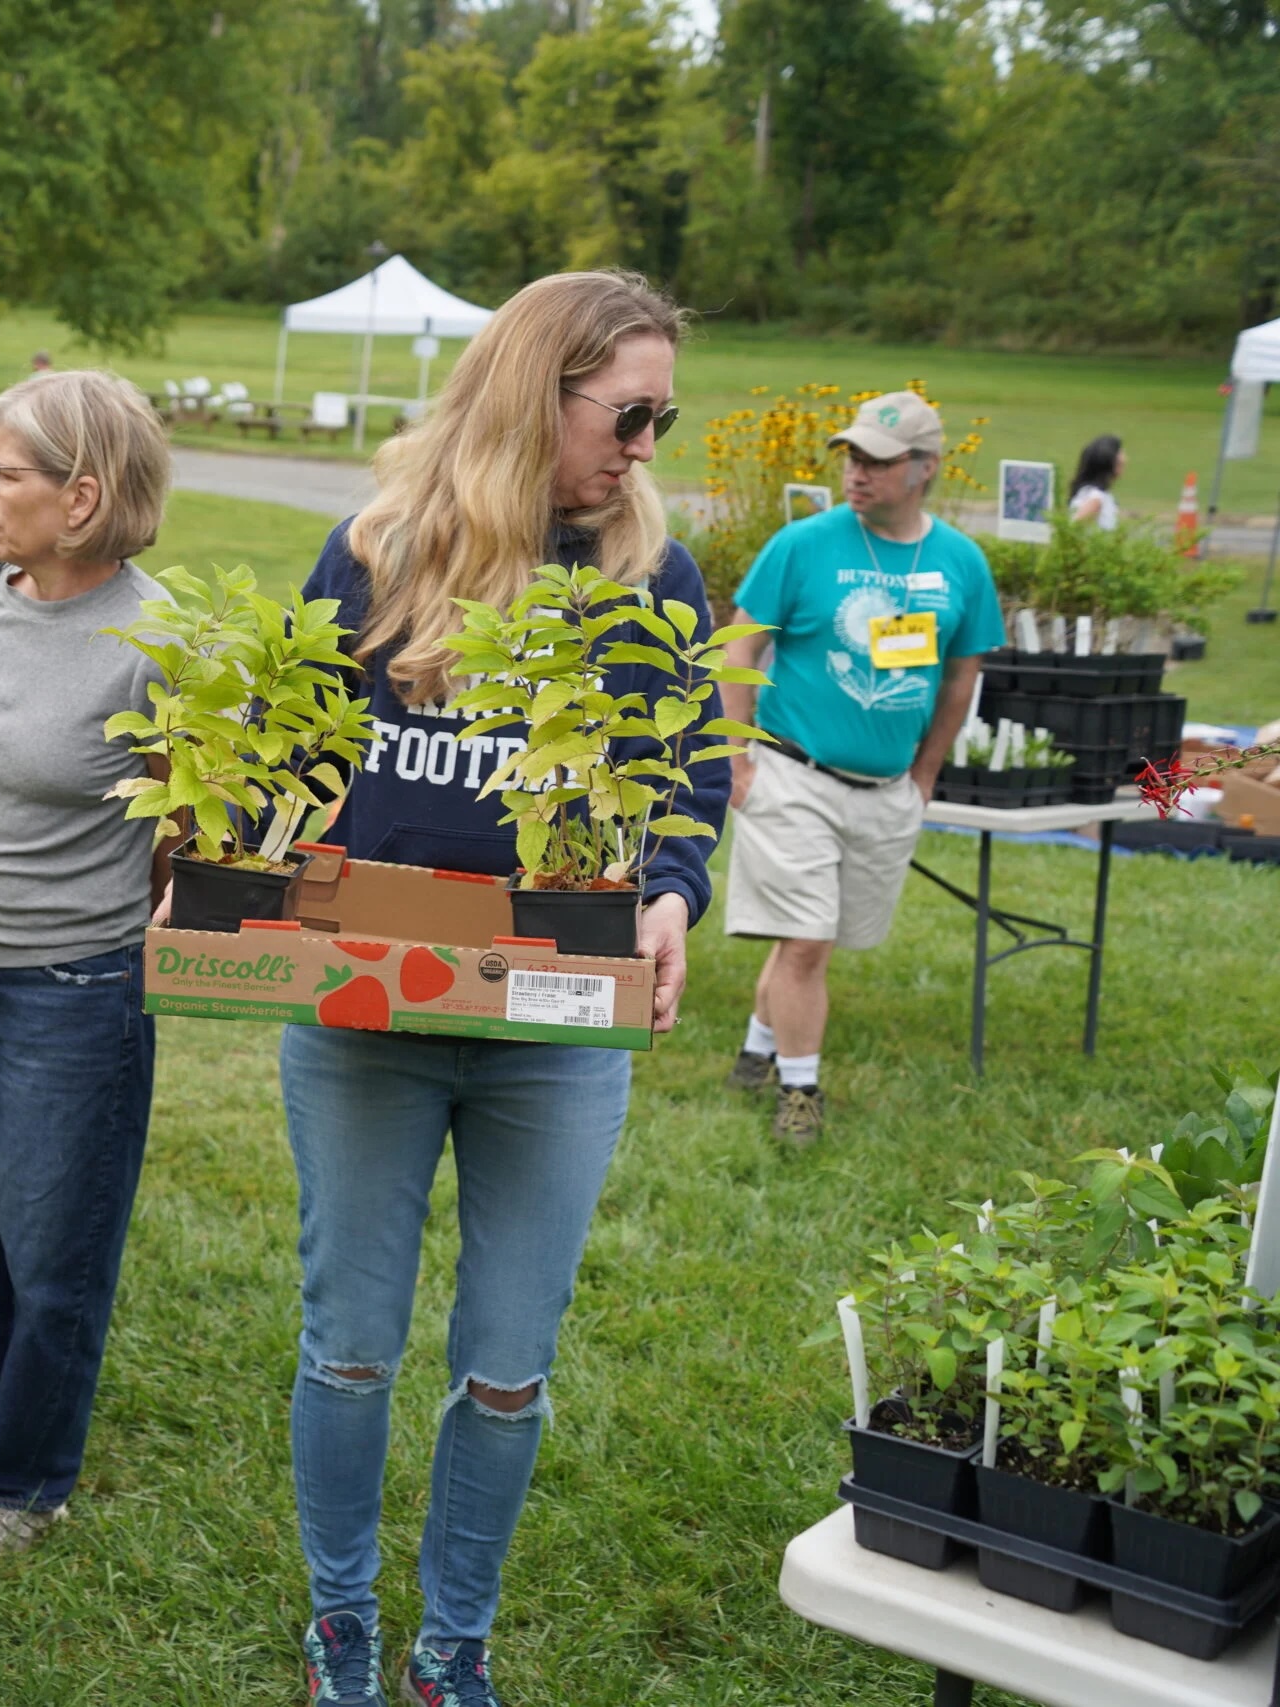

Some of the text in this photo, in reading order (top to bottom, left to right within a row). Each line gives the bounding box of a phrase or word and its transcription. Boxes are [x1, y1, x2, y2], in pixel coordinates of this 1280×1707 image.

[364, 720, 609, 794] FOOTB
[155, 947, 296, 983] Driscoll's
[485, 960, 502, 968] USDA
[172, 977, 193, 987] Only
[195, 978, 211, 987] the
[212, 980, 242, 991] Finest
[159, 998, 293, 1018] Organic Strawberries
